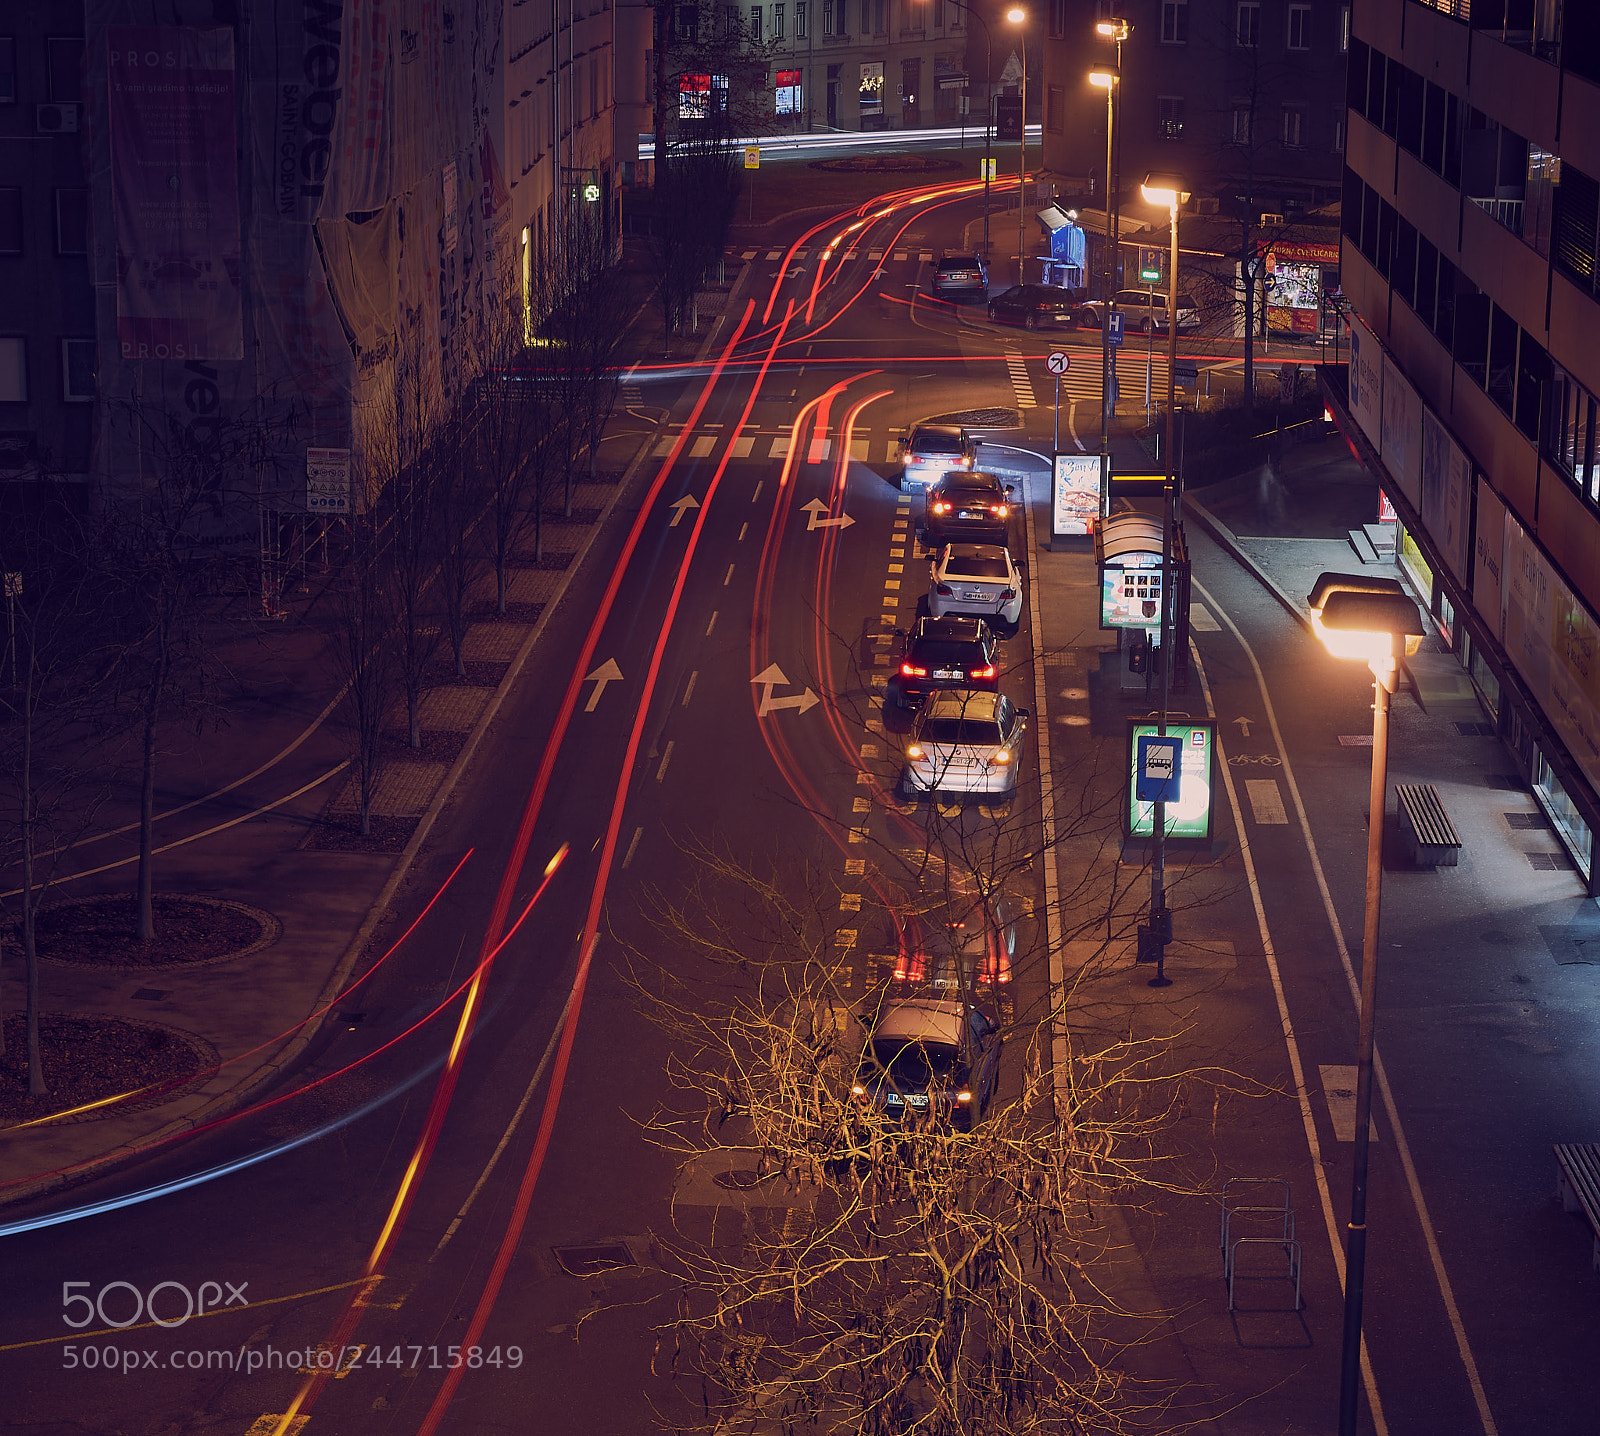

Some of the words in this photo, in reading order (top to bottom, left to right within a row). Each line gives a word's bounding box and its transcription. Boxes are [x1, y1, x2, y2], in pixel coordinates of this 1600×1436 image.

[124, 83, 145, 92] vami
[147, 83, 185, 95] gradimo
[280, 84, 299, 214] SAINT-GOBAIN
[1108, 314, 1120, 332] H
